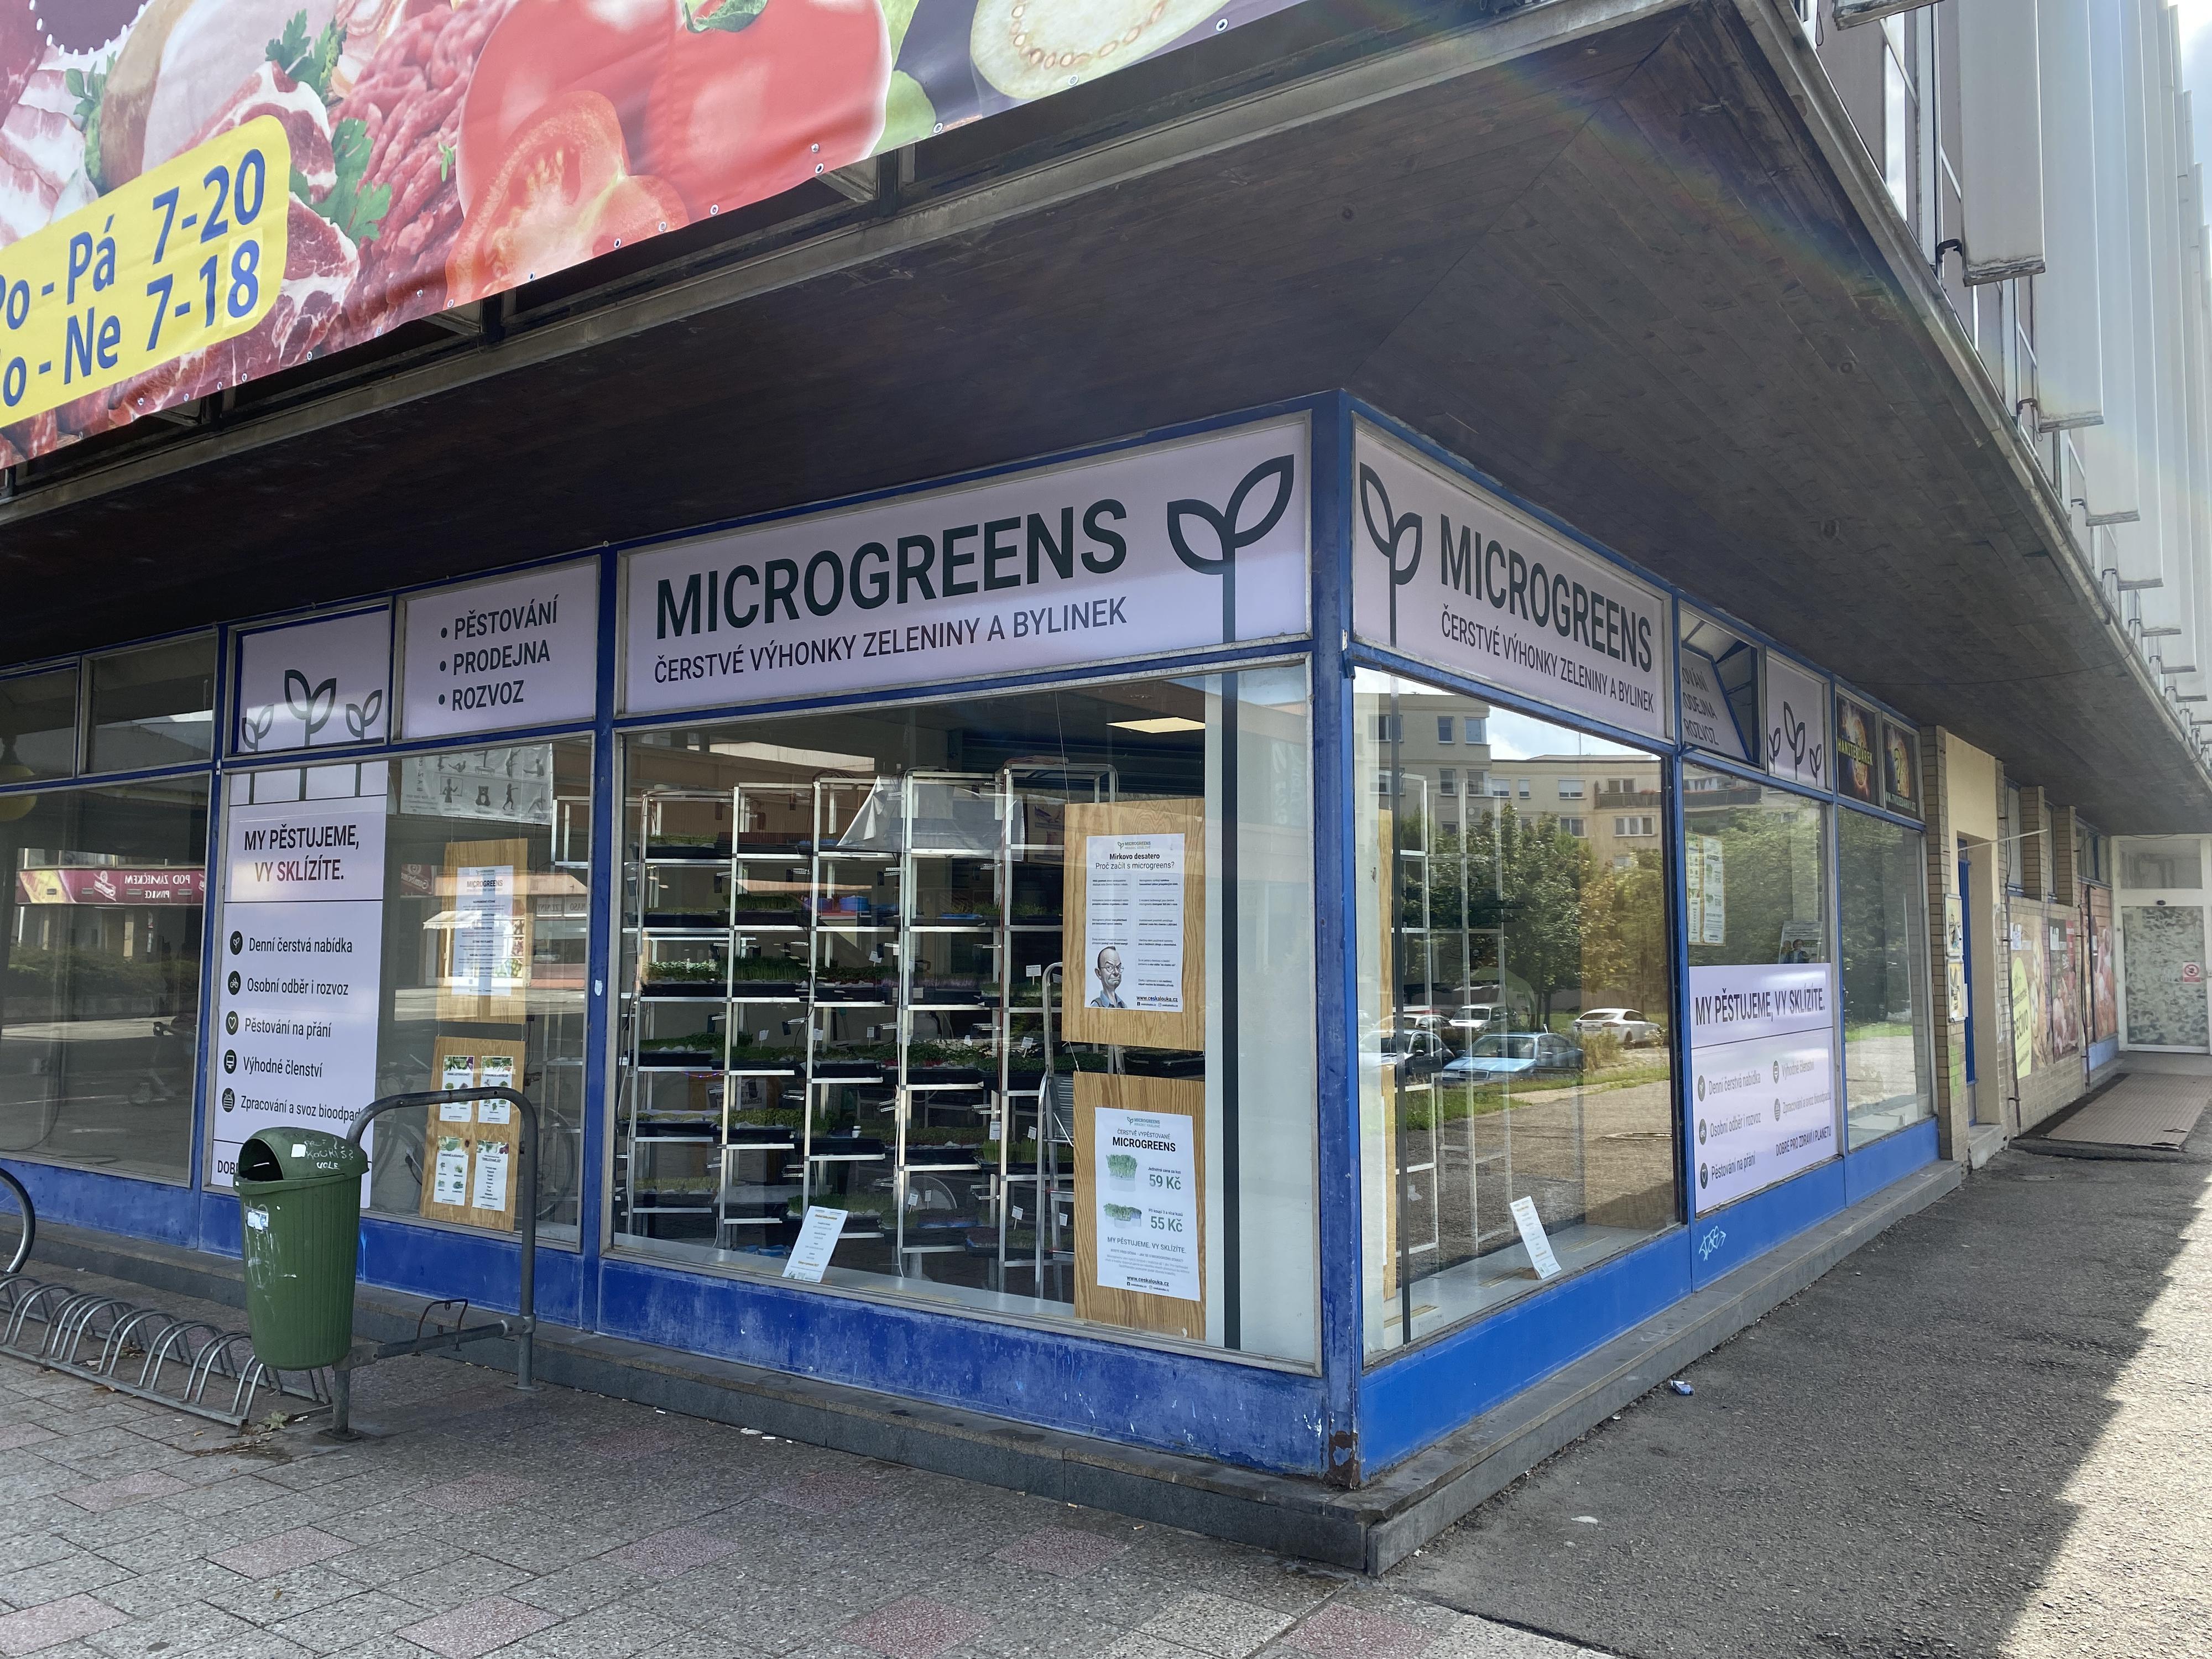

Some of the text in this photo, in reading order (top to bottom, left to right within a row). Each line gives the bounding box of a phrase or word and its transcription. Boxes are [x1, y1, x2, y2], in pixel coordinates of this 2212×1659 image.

[0, 275, 30, 330] o
[66, 215, 116, 305] Pá
[152, 148, 265, 265] 7-20
[2, 357, 27, 407] o
[64, 307, 121, 385] Ne
[146, 239, 260, 352] 7-18
[656, 498, 1127, 640] MICROGREENS
[1441, 513, 1652, 673] MICROGREENS
[454, 594, 559, 640] PĚSTOVÁNÍ
[655, 596, 1128, 684] ČERSTVÉ VÝHONKY ZELENINY A BYLINEK
[453, 639, 550, 676] PRODEJNA
[1441, 603, 1654, 714] ČERSTVÉ VÝHONKY ZELENINY A BYLINEK
[1682, 667, 1709, 693] OVÁNÍ
[452, 680, 524, 711] ROZVOZ
[1683, 718, 1719, 745] ROZVOZ
[244, 823, 359, 851] MY PĚSTUJEME,
[254, 854, 344, 881] VY SKLÍZÍTE.
[1132, 861, 1175, 870] microgreens?
[466, 879, 503, 888] MICROGREENS
[249, 937, 353, 953] Denní čerstvá nabídka
[247, 978, 349, 995] Osobní odběr i rozvoz
[1695, 982, 1825, 1026] MY PĚSTUJEME, VY SKLÍZÍTE.
[244, 1018, 332, 1040] Pěstování na přání
[243, 1056, 323, 1078] Výhodné členství
[1709, 1070, 1761, 1095] Denní čerstvá nabídka
[241, 1095, 361, 1124] Zpracování a svoz bioodpad
[1710, 1118, 1728, 1138] Osobní
[1729, 1114, 1743, 1132] odběr
[1746, 1113, 1761, 1126] rozvoz
[1112, 1136, 1176, 1152] MICROGREENS
[1776, 1137, 1790, 1156] DOBRÉ
[1790, 1137, 1798, 1150] PRO
[1799, 1129, 1813, 1147] ZDRAVÍ
[217, 1160, 238, 1175] DOB
[1712, 1150, 1755, 1181] Pěstování na přání
[1149, 1174, 1181, 1190] 59 Kč
[1151, 1216, 1183, 1233] 55 Kč
[1161, 1244, 1186, 1254] SKLÍZÍTE.
[1126, 1276, 1170, 1287] www.ceskalouka.cz
